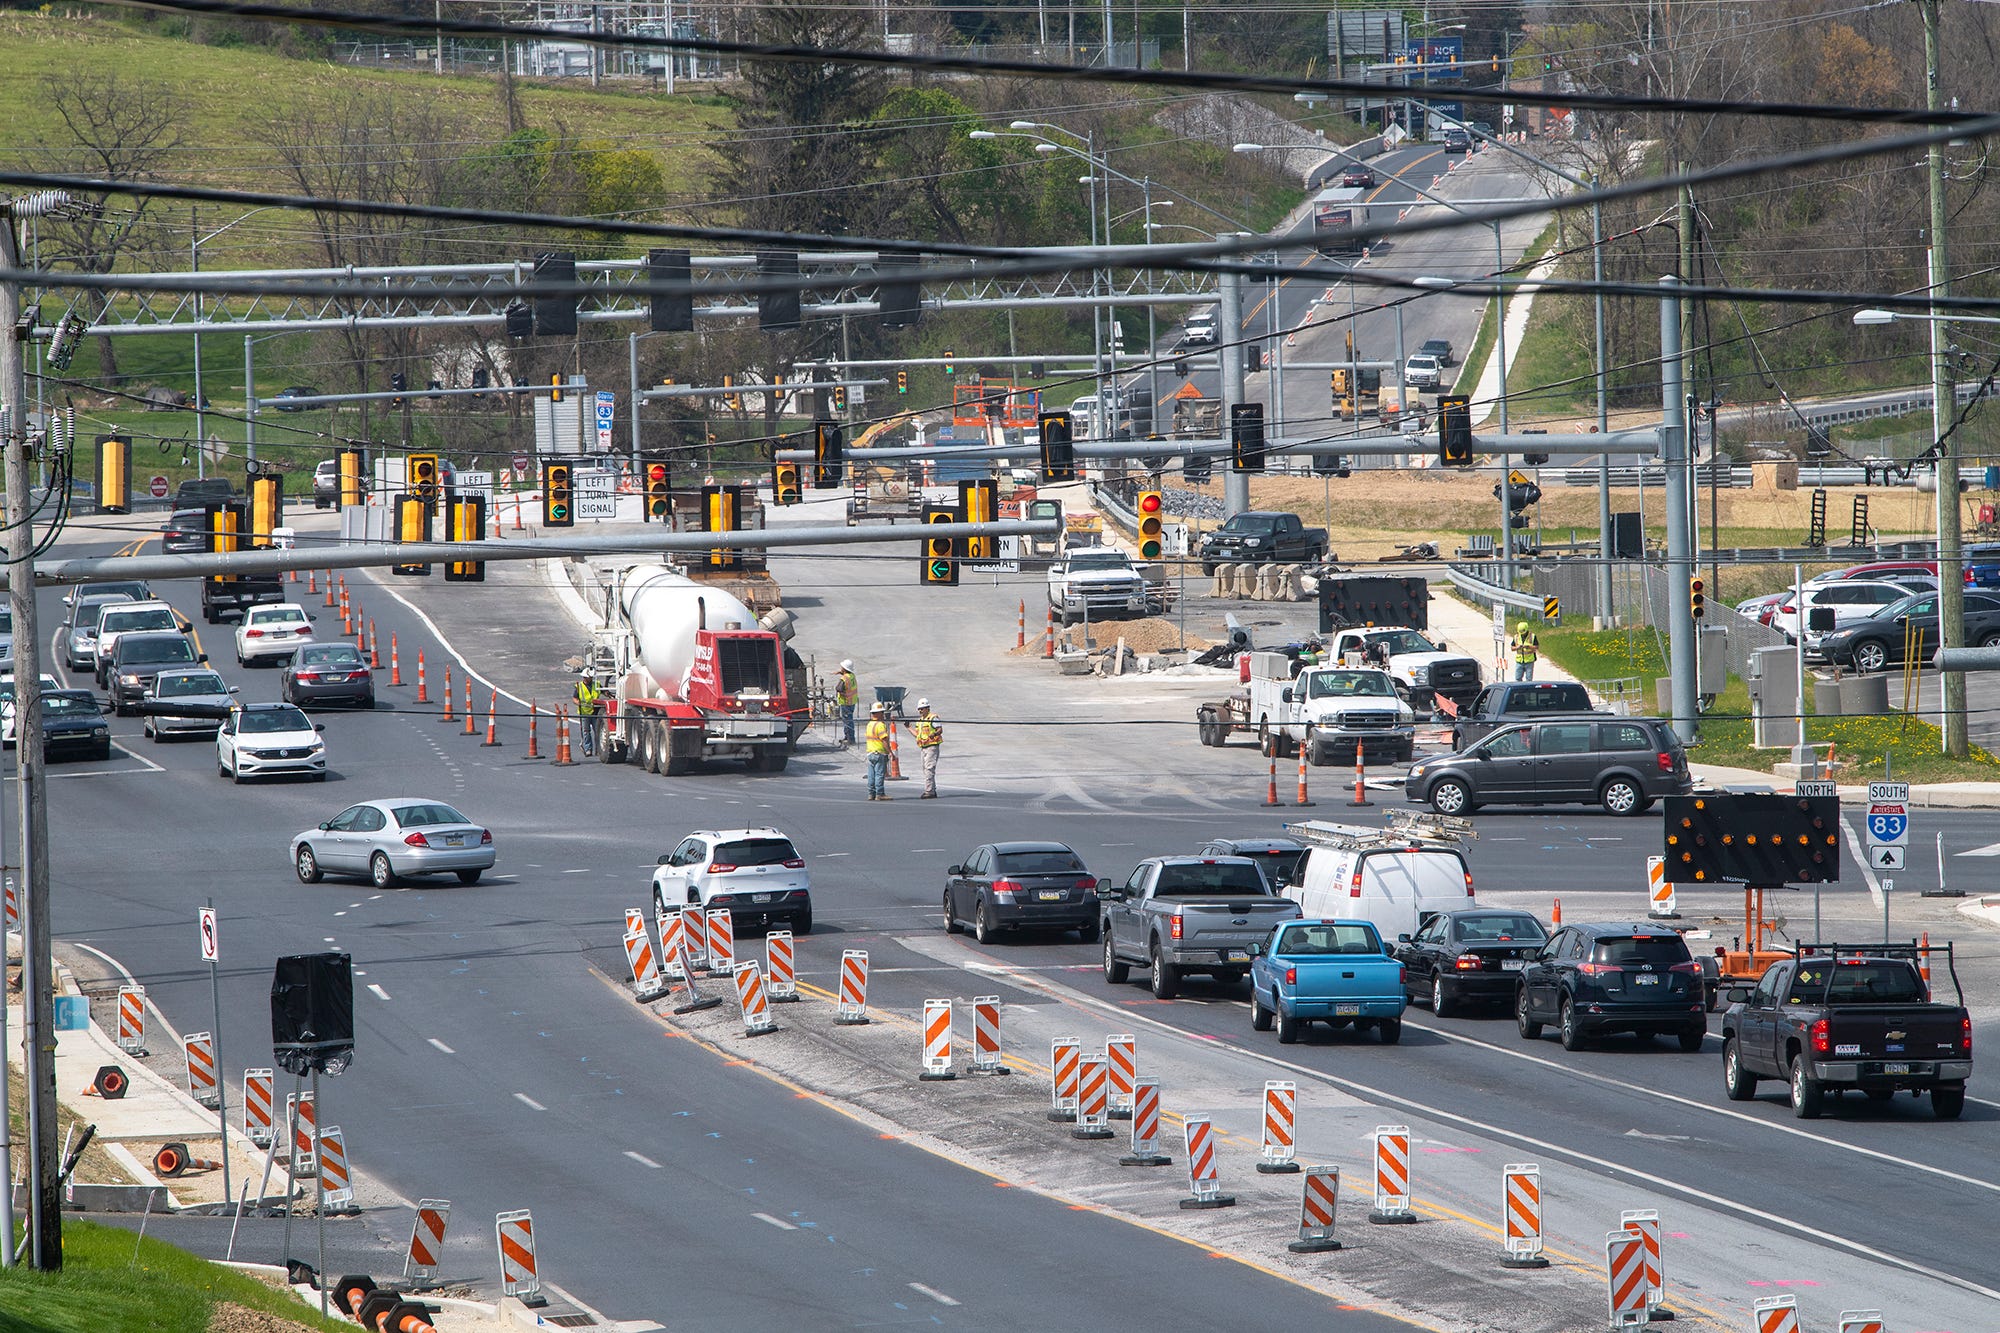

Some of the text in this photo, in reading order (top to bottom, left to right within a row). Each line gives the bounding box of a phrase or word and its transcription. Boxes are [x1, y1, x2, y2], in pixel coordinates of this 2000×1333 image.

[599, 407, 611, 416] 83
[463, 475, 483, 485] LEFT
[585, 478, 607, 487] LEFT
[462, 489, 485, 497] TURN
[585, 491, 608, 500] TURN
[582, 504, 613, 513] SIGNAL
[1798, 784, 1834, 796] NORTH
[1872, 786, 1906, 798] SOUTH
[1874, 806, 1901, 814] INTERSTATE
[1874, 816, 1901, 834] 83
